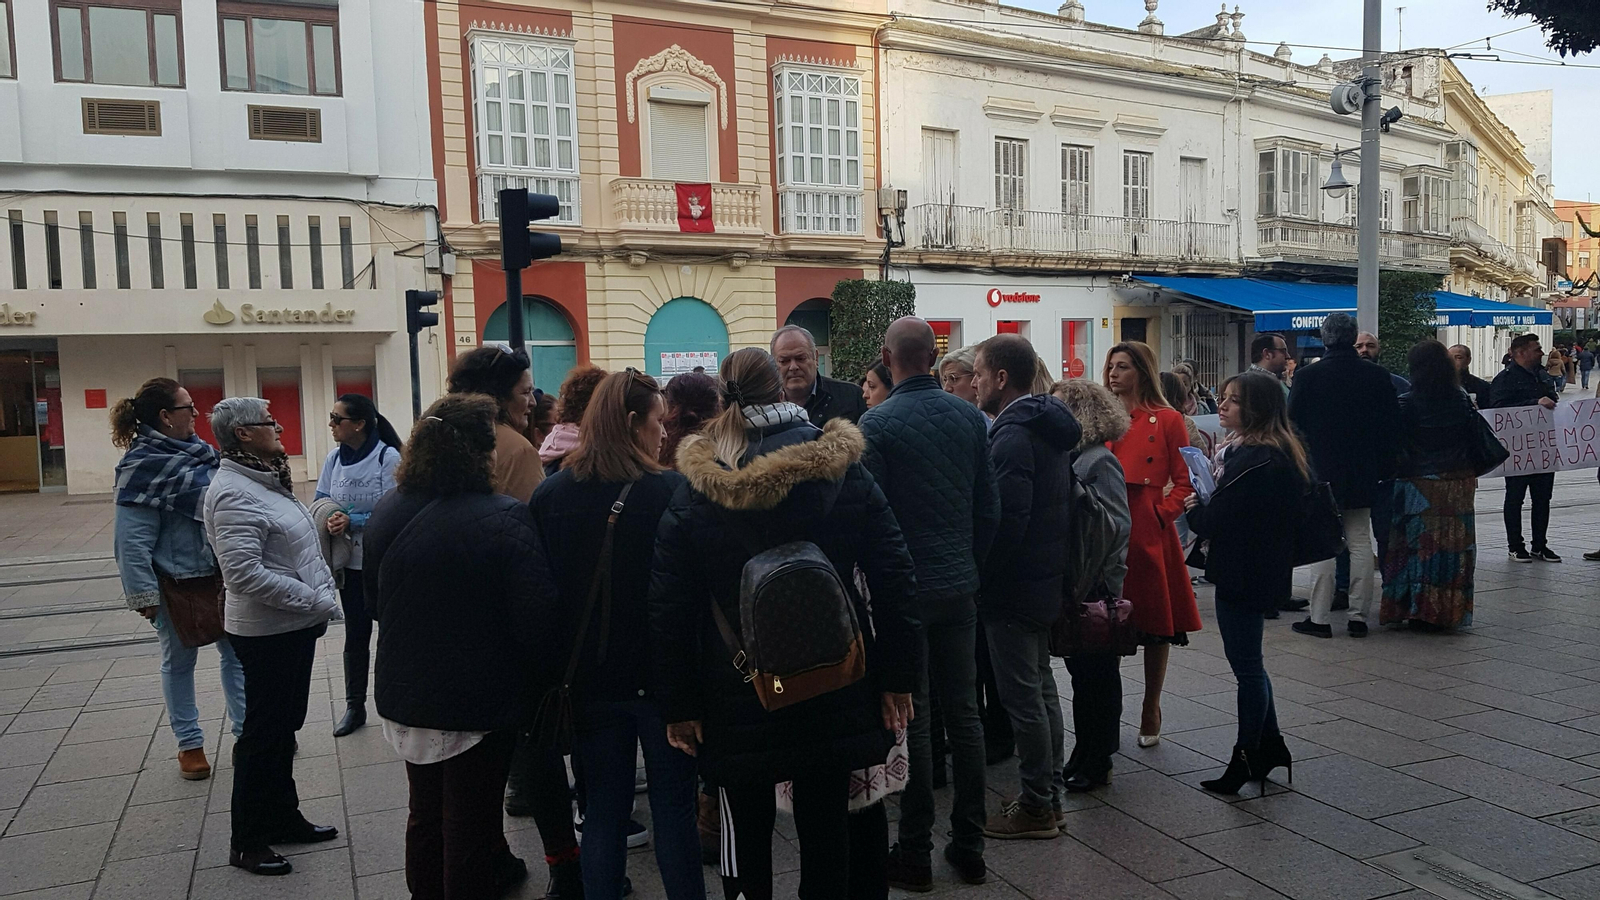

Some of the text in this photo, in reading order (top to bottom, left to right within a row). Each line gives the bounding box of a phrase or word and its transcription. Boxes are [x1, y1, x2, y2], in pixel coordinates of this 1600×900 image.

[1002, 291, 1041, 303] vodafone
[240, 302, 356, 324] Santander
[1495, 408, 1547, 432] BASTA
